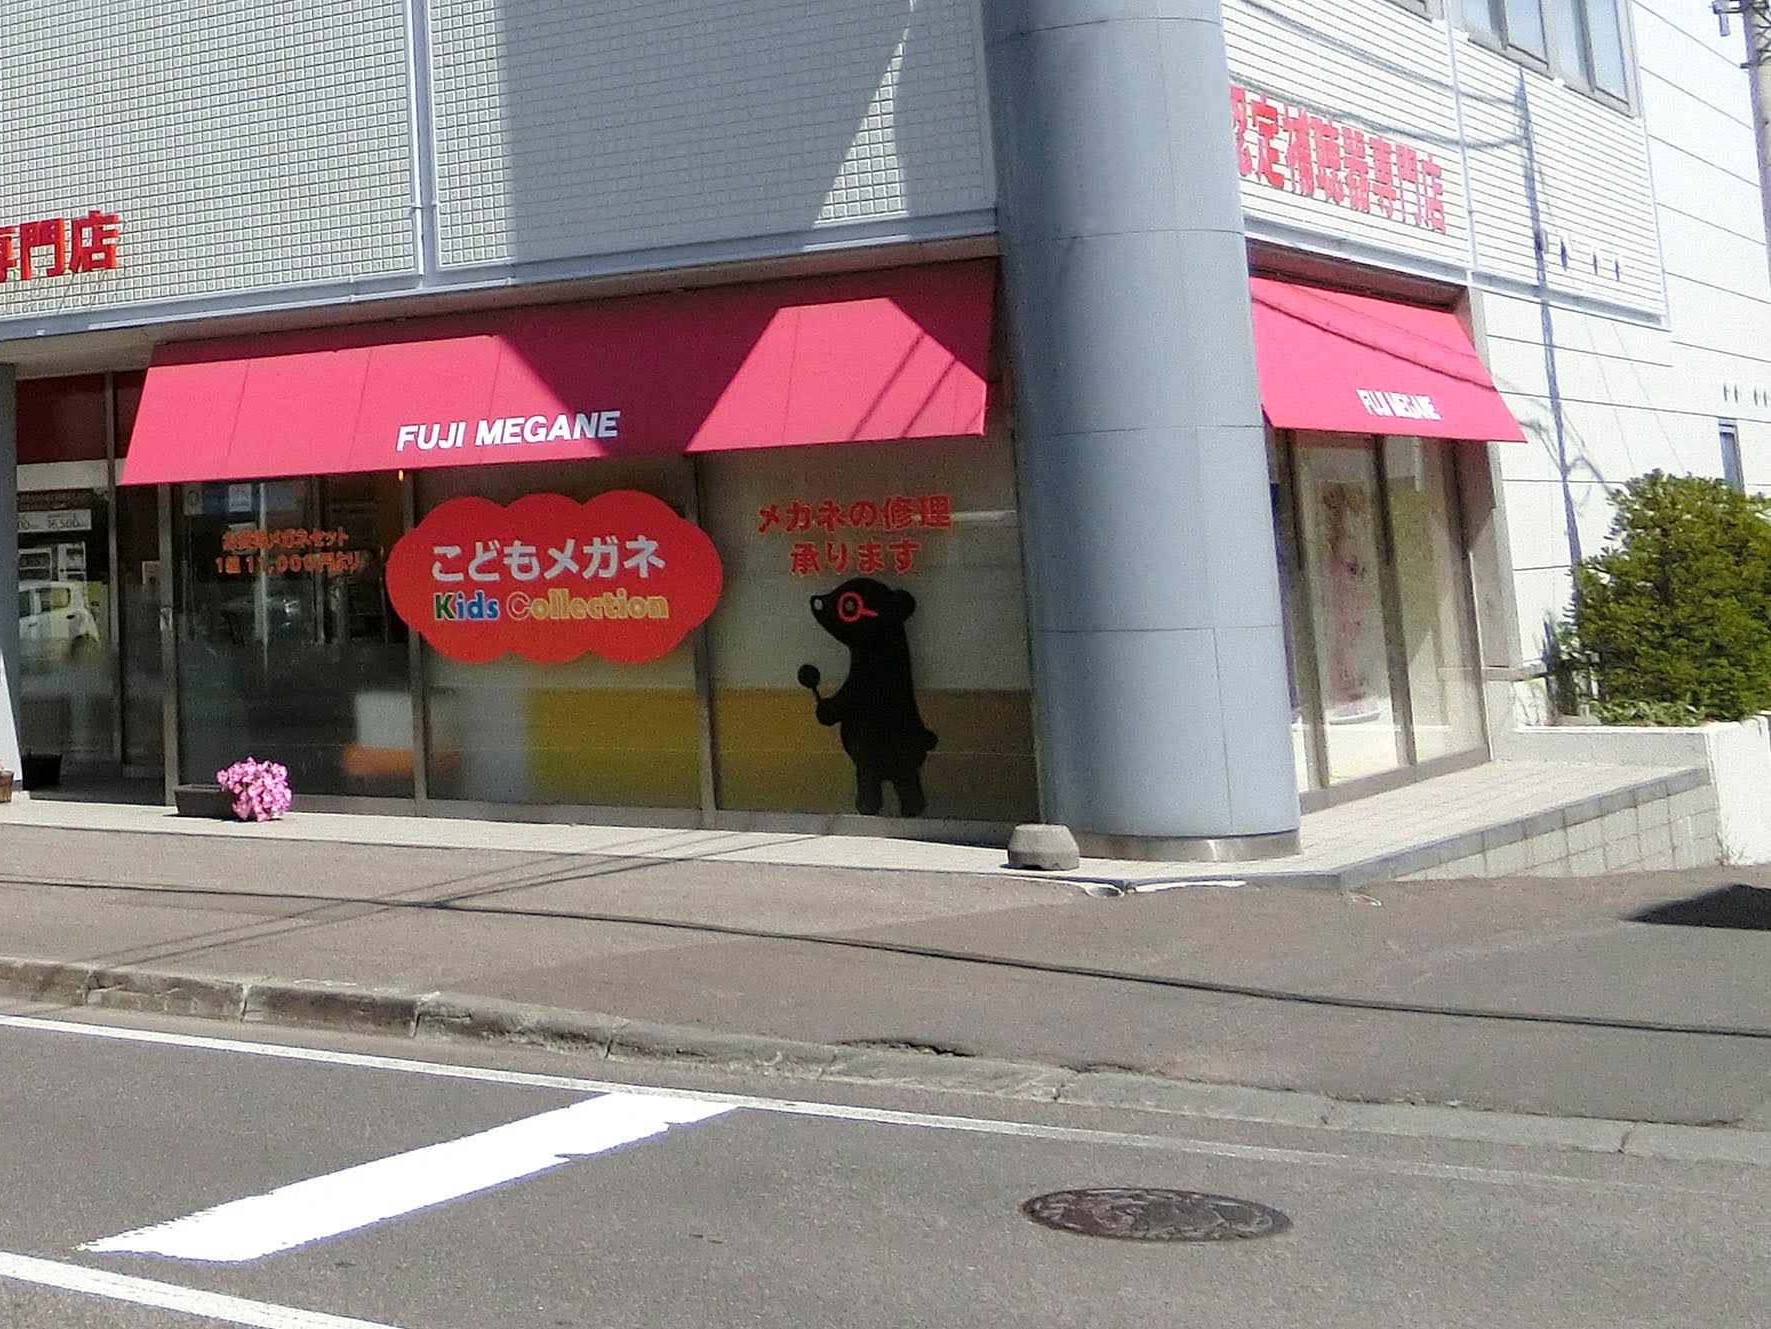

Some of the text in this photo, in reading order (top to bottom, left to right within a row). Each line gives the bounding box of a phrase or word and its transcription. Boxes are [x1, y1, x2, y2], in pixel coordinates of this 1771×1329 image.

[395, 410, 621, 452] FUJI MEGANE
[757, 494, 953, 534] メガネの修理
[431, 534, 666, 582] こどもメガネ
[789, 536, 921, 576] 承ります
[433, 587, 671, 622] Kids Collection
